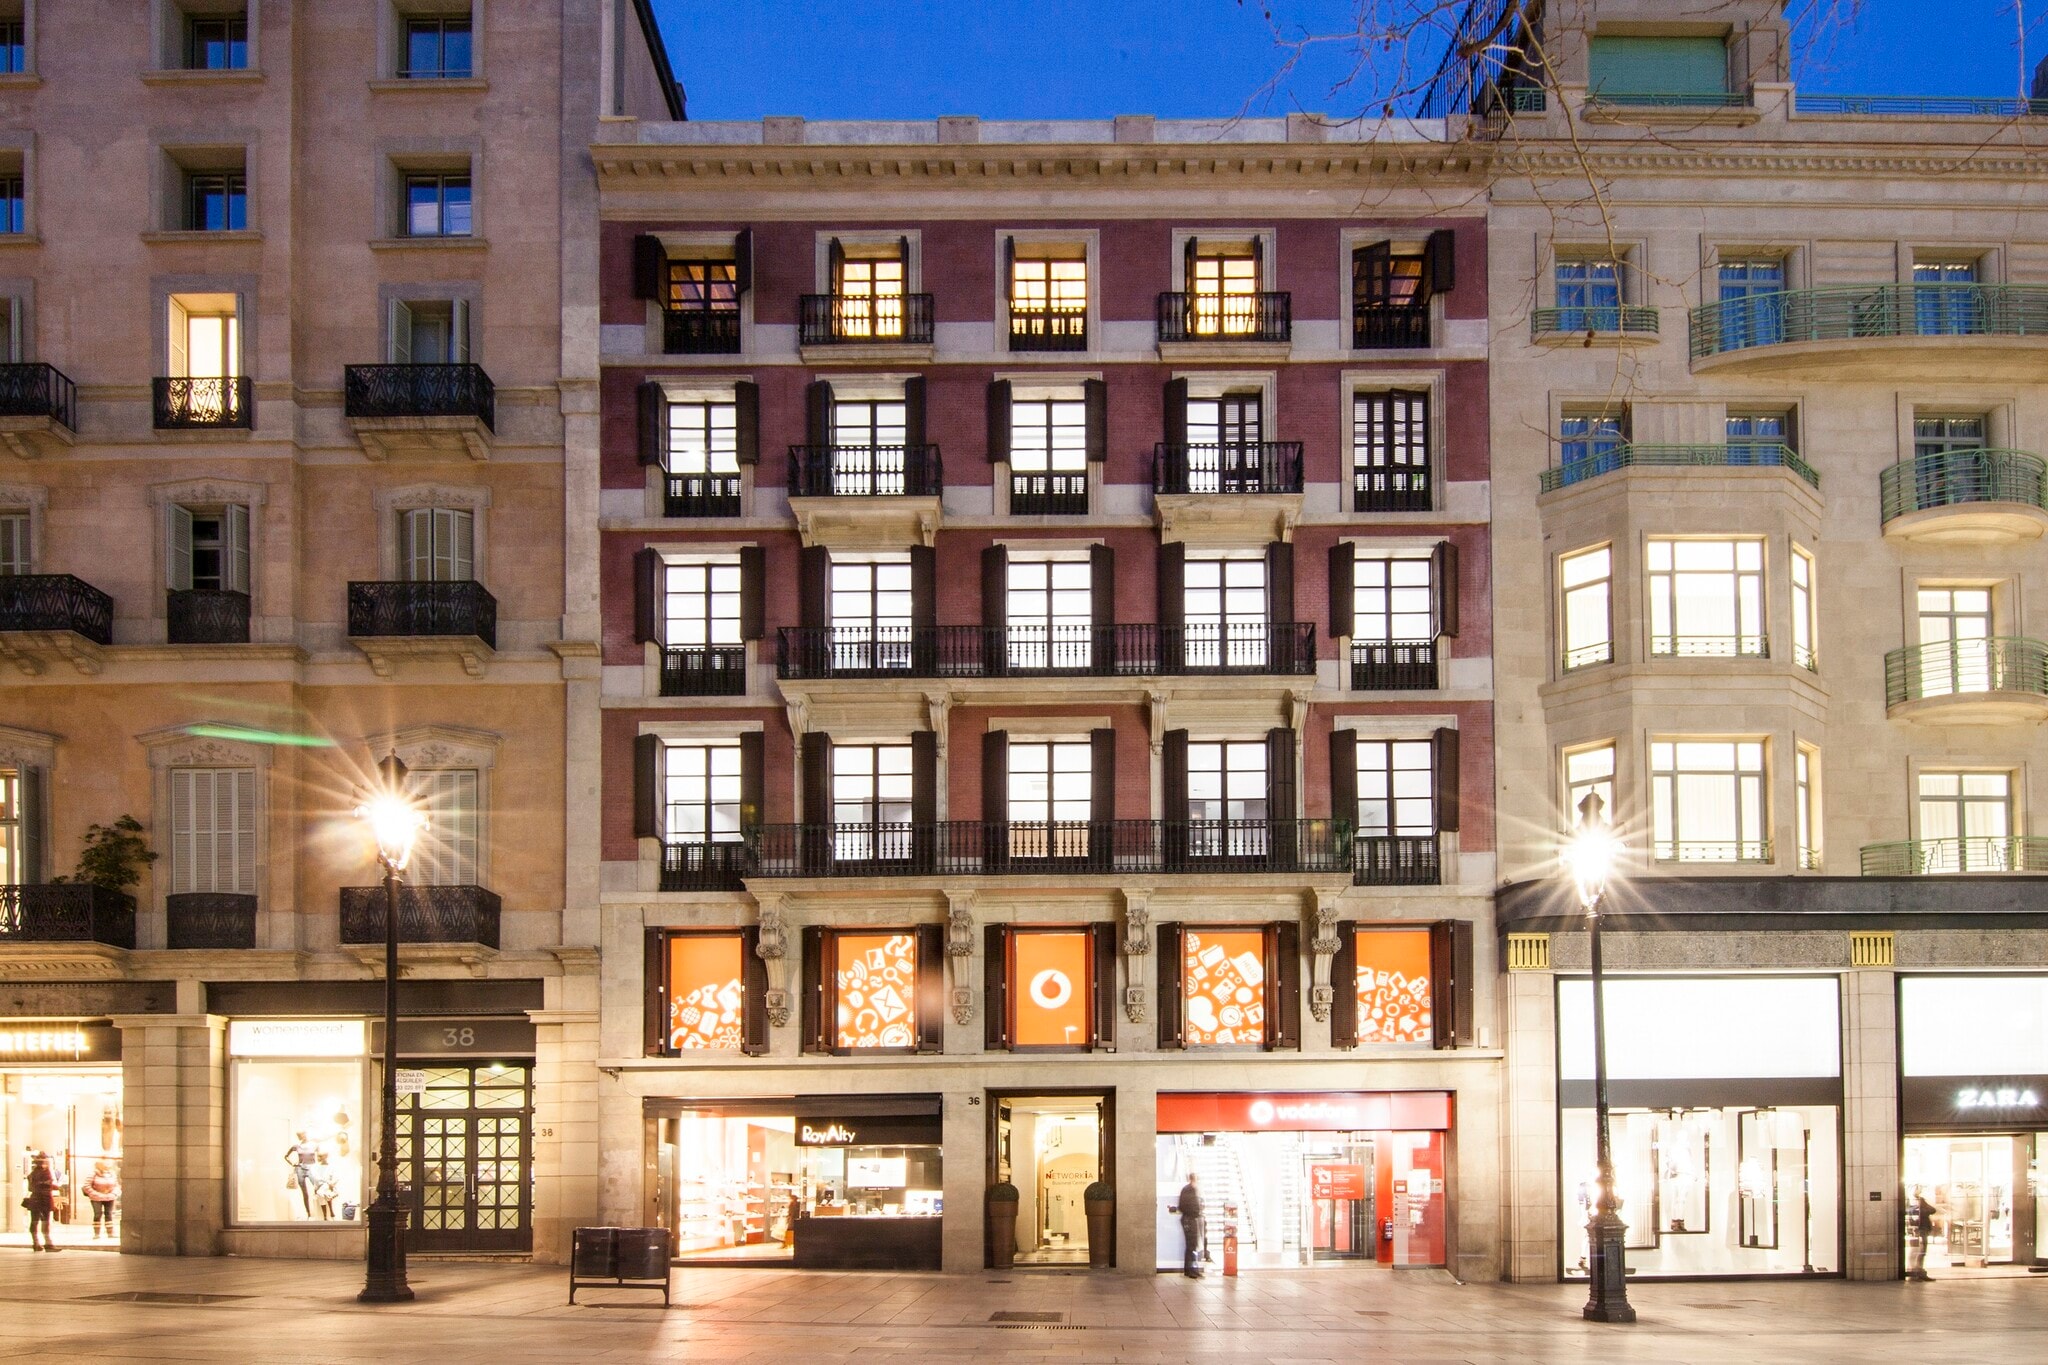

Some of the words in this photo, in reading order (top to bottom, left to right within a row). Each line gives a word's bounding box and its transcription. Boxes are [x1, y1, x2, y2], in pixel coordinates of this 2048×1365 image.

[442, 1027, 475, 1047] 38
[968, 1096, 980, 1106] 36
[1957, 1088, 2039, 1107] ZARA
[1276, 1102, 1358, 1120] vodafone
[541, 1128, 553, 1137] 38
[802, 1124, 856, 1144] RoyAlty
